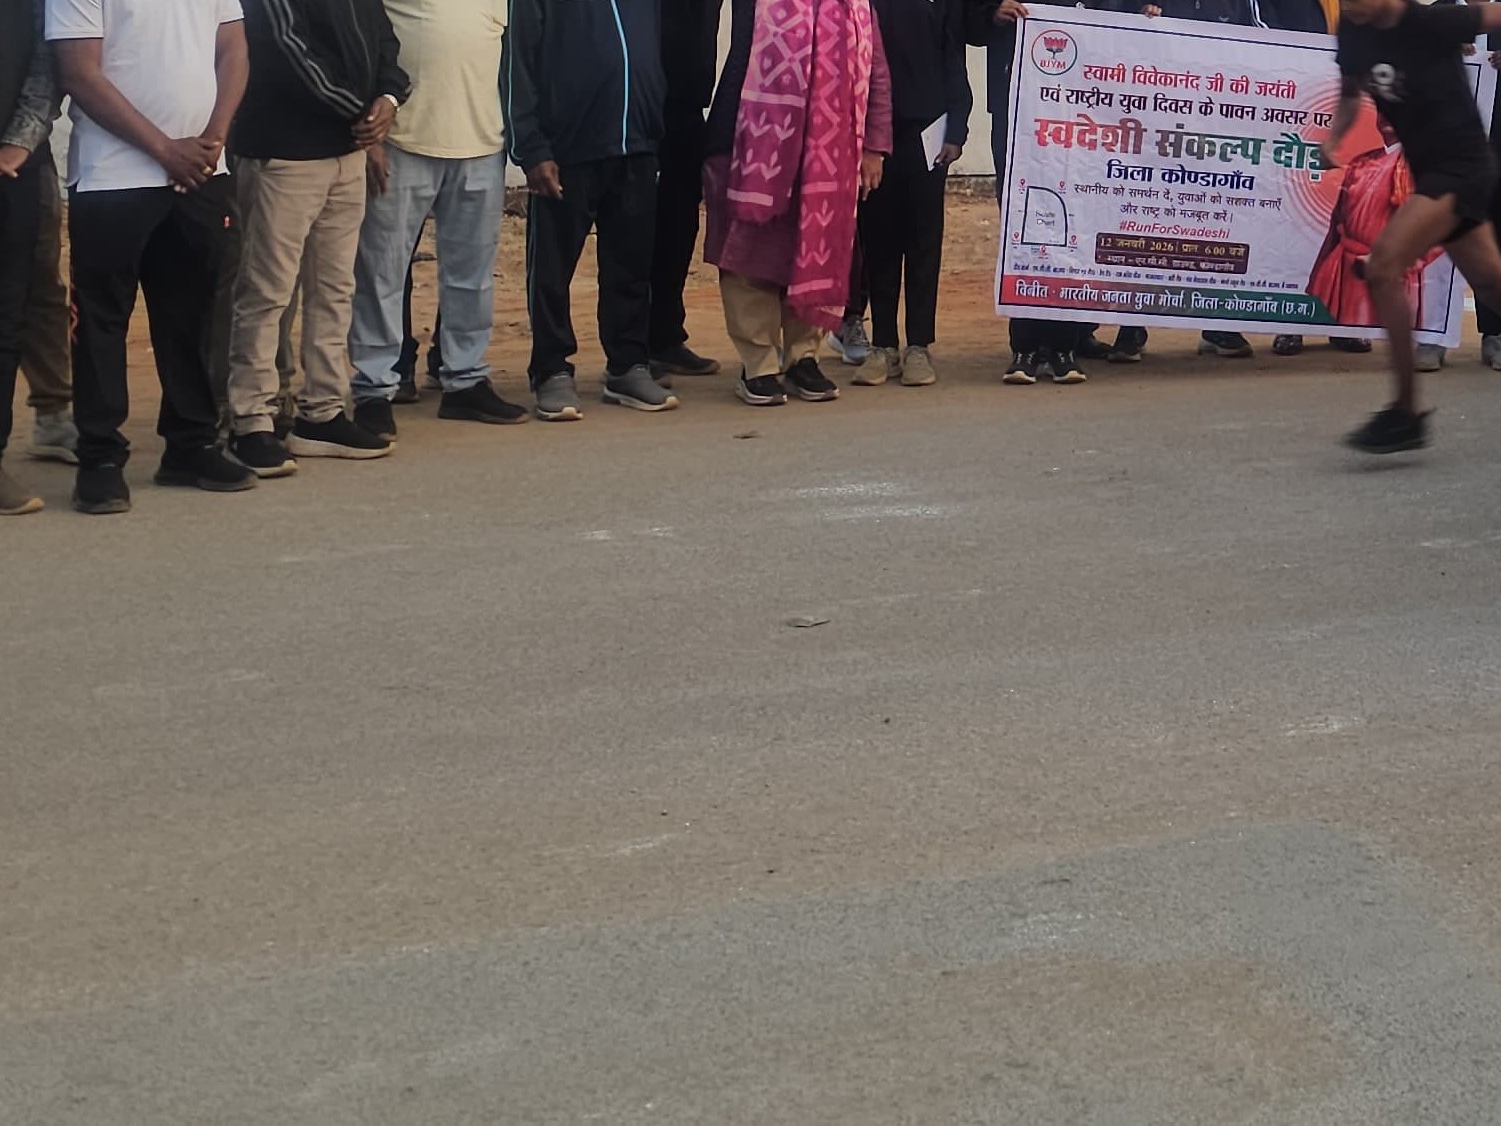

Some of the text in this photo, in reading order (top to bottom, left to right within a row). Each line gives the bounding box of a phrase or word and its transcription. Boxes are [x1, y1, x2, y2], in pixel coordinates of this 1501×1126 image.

[1040, 59, 1066, 69] BJYM
[1083, 63, 1297, 99] स्वामी विवेकानंद जी की जयंती
[1040, 83, 1333, 128] एवं राष्ट्रीय युवा दिवस के पावन अवसर पर
[1034, 113, 1147, 155] स्वदेशी
[1155, 123, 1266, 165] संकल्प
[1106, 159, 1255, 191] जिला कोण्डागाँव
[1073, 182, 1109, 195] स्थानीय
[1113, 183, 1125, 196] को
[1128, 186, 1159, 200] समर्थन
[1177, 192, 1206, 205] युवाओं
[1210, 191, 1222, 205] को
[1226, 196, 1255, 208] सशक्त
[1120, 202, 1138, 215] और
[1141, 205, 1160, 220] राष्ट्र
[1164, 204, 1176, 218] को
[1179, 210, 1209, 223] मजबूत
[1119, 220, 1230, 239] #RunForSwadeshi
[1100, 237, 1112, 248] 12
[1116, 237, 1145, 249] जनवरी
[1149, 240, 1174, 252] 2026
[1015, 279, 1048, 298] विनीत
[1059, 284, 1099, 302] भारतीय
[1101, 290, 1132, 305] जनता
[1134, 293, 1154, 310] युवा
[1281, 299, 1316, 318] (छ.ग.)
